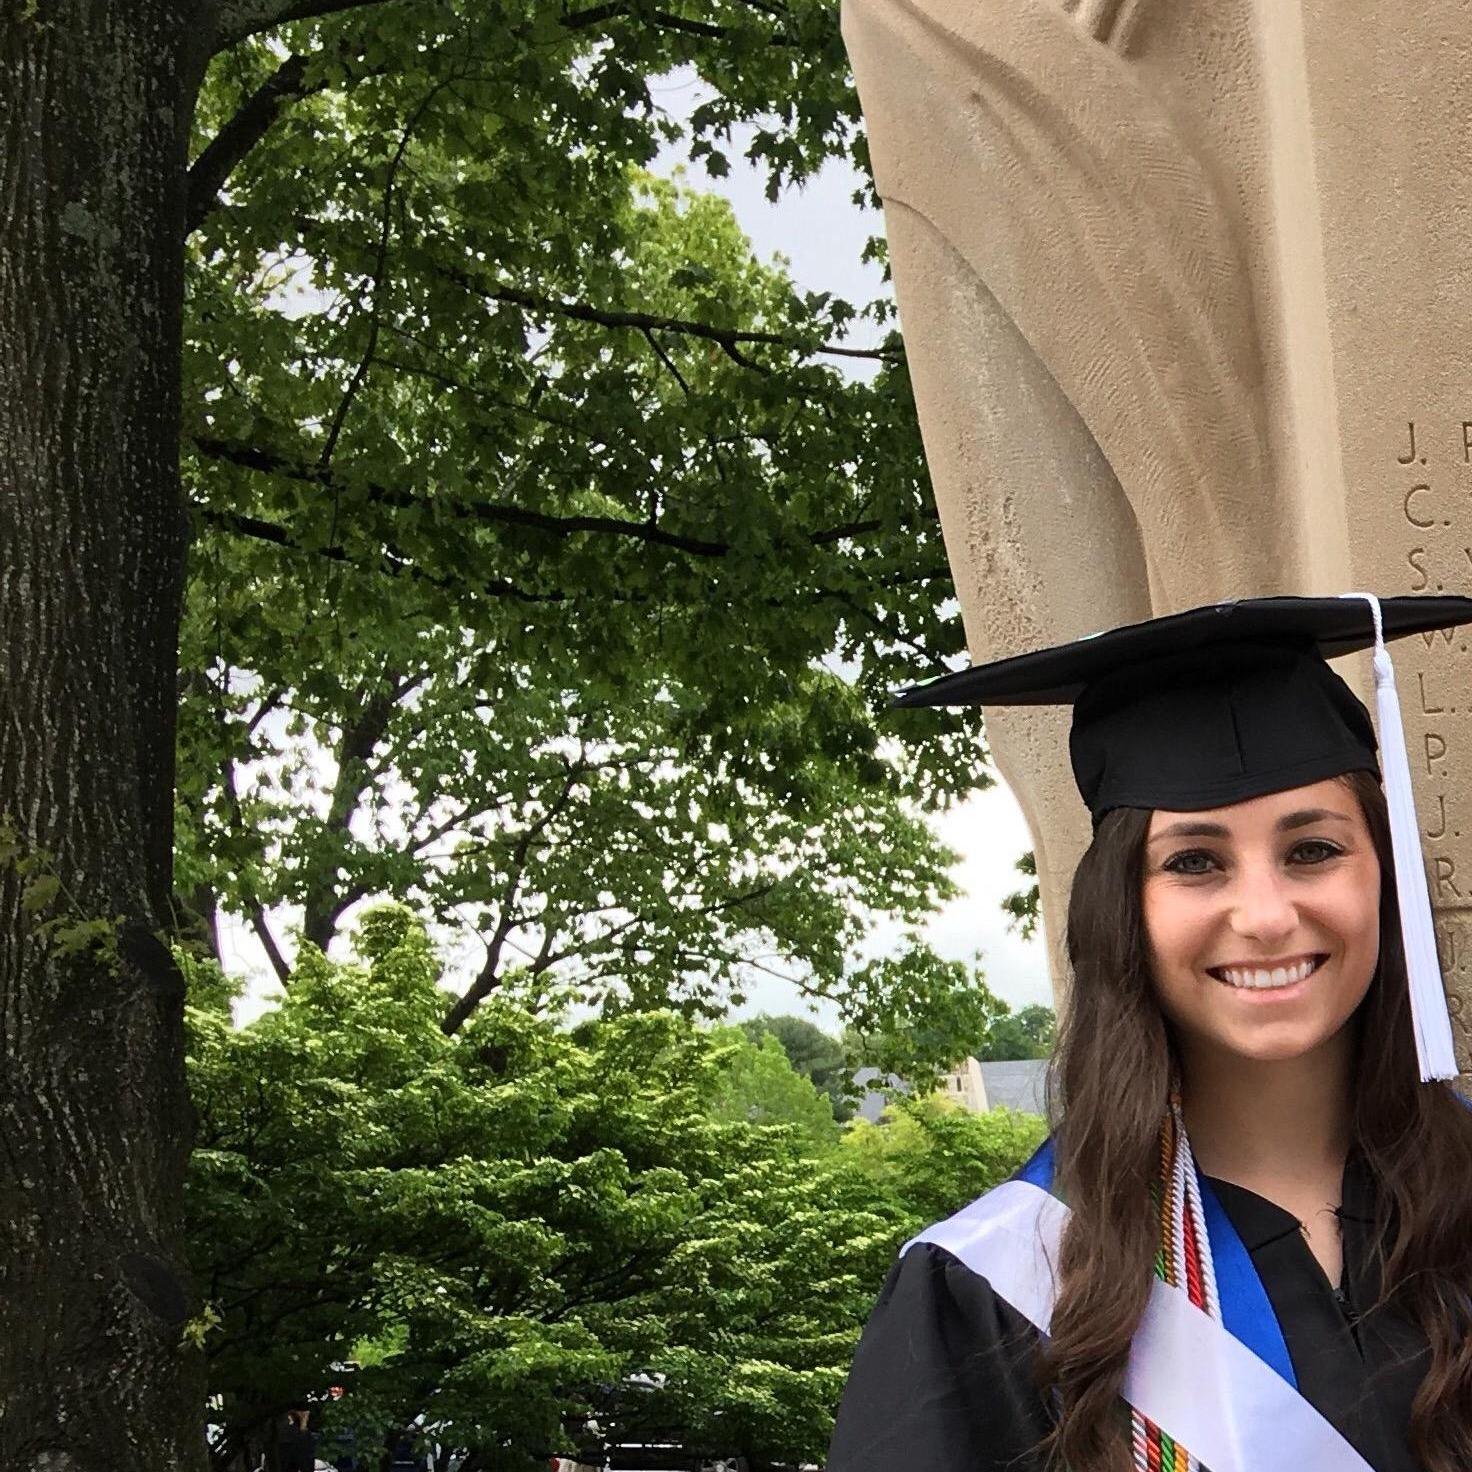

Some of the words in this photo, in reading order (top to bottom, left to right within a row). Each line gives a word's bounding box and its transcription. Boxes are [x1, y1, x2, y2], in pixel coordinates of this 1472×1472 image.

[1398, 421, 1427, 465] J.
[1404, 484, 1450, 528] C.
[1410, 548, 1443, 592] S.
[1425, 733, 1448, 777] P.
[1427, 795, 1460, 839] J.
